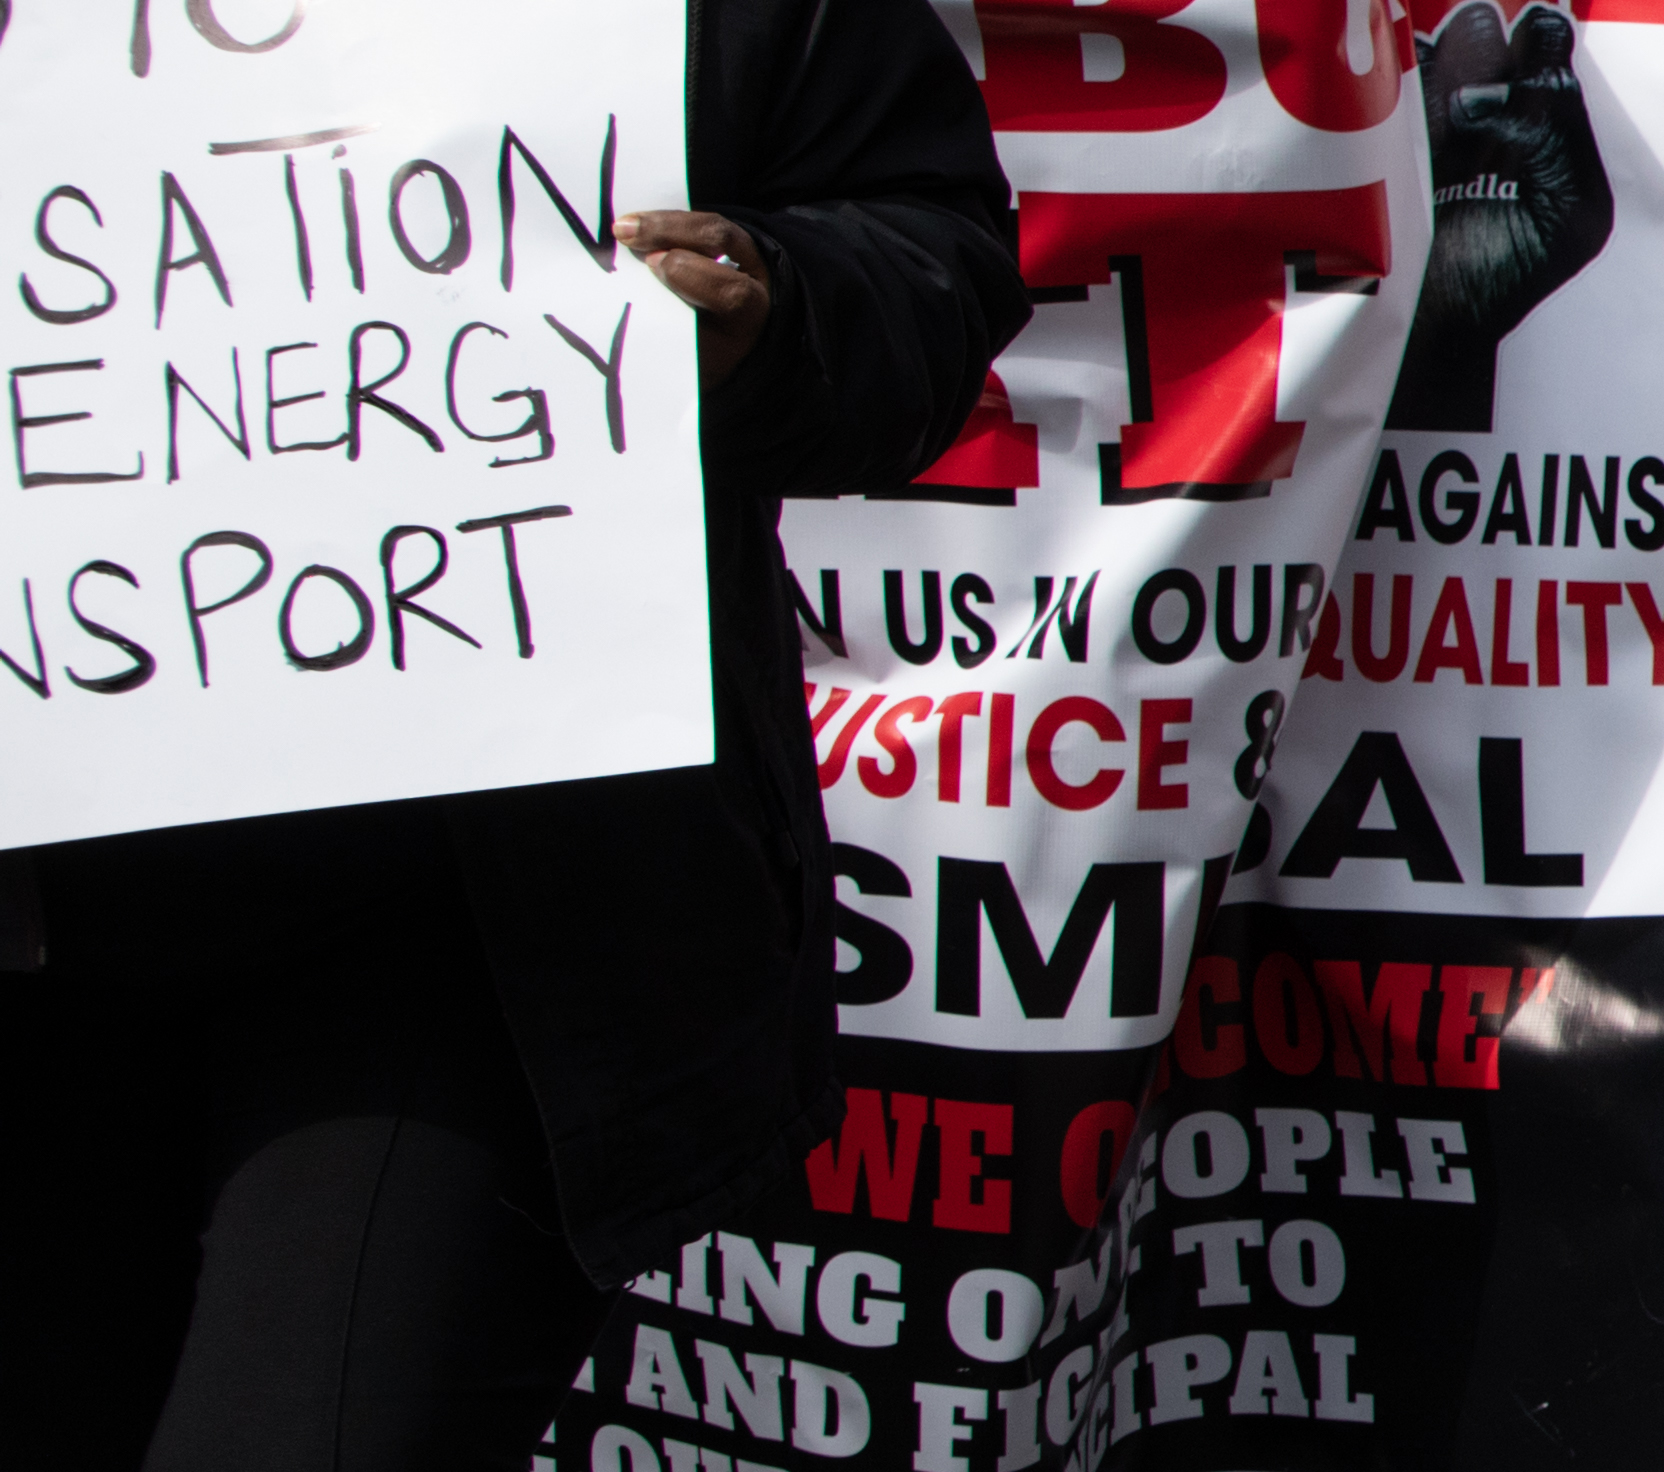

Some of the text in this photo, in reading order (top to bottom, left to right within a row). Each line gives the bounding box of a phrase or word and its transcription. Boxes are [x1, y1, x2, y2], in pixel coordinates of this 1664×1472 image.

[1433, 173, 1520, 205] andla
[10, 301, 632, 489] ENERGY
[883, 569, 997, 669] US
[1007, 570, 1100, 663] IN
[1132, 563, 1326, 665] OUR
[805, 682, 1193, 811] USTICE
[805, 1088, 1015, 1234] WE
[625, 1230, 905, 1347] ING
[626, 1324, 871, 1458] AND
[1172, 1218, 1346, 1308] TO
